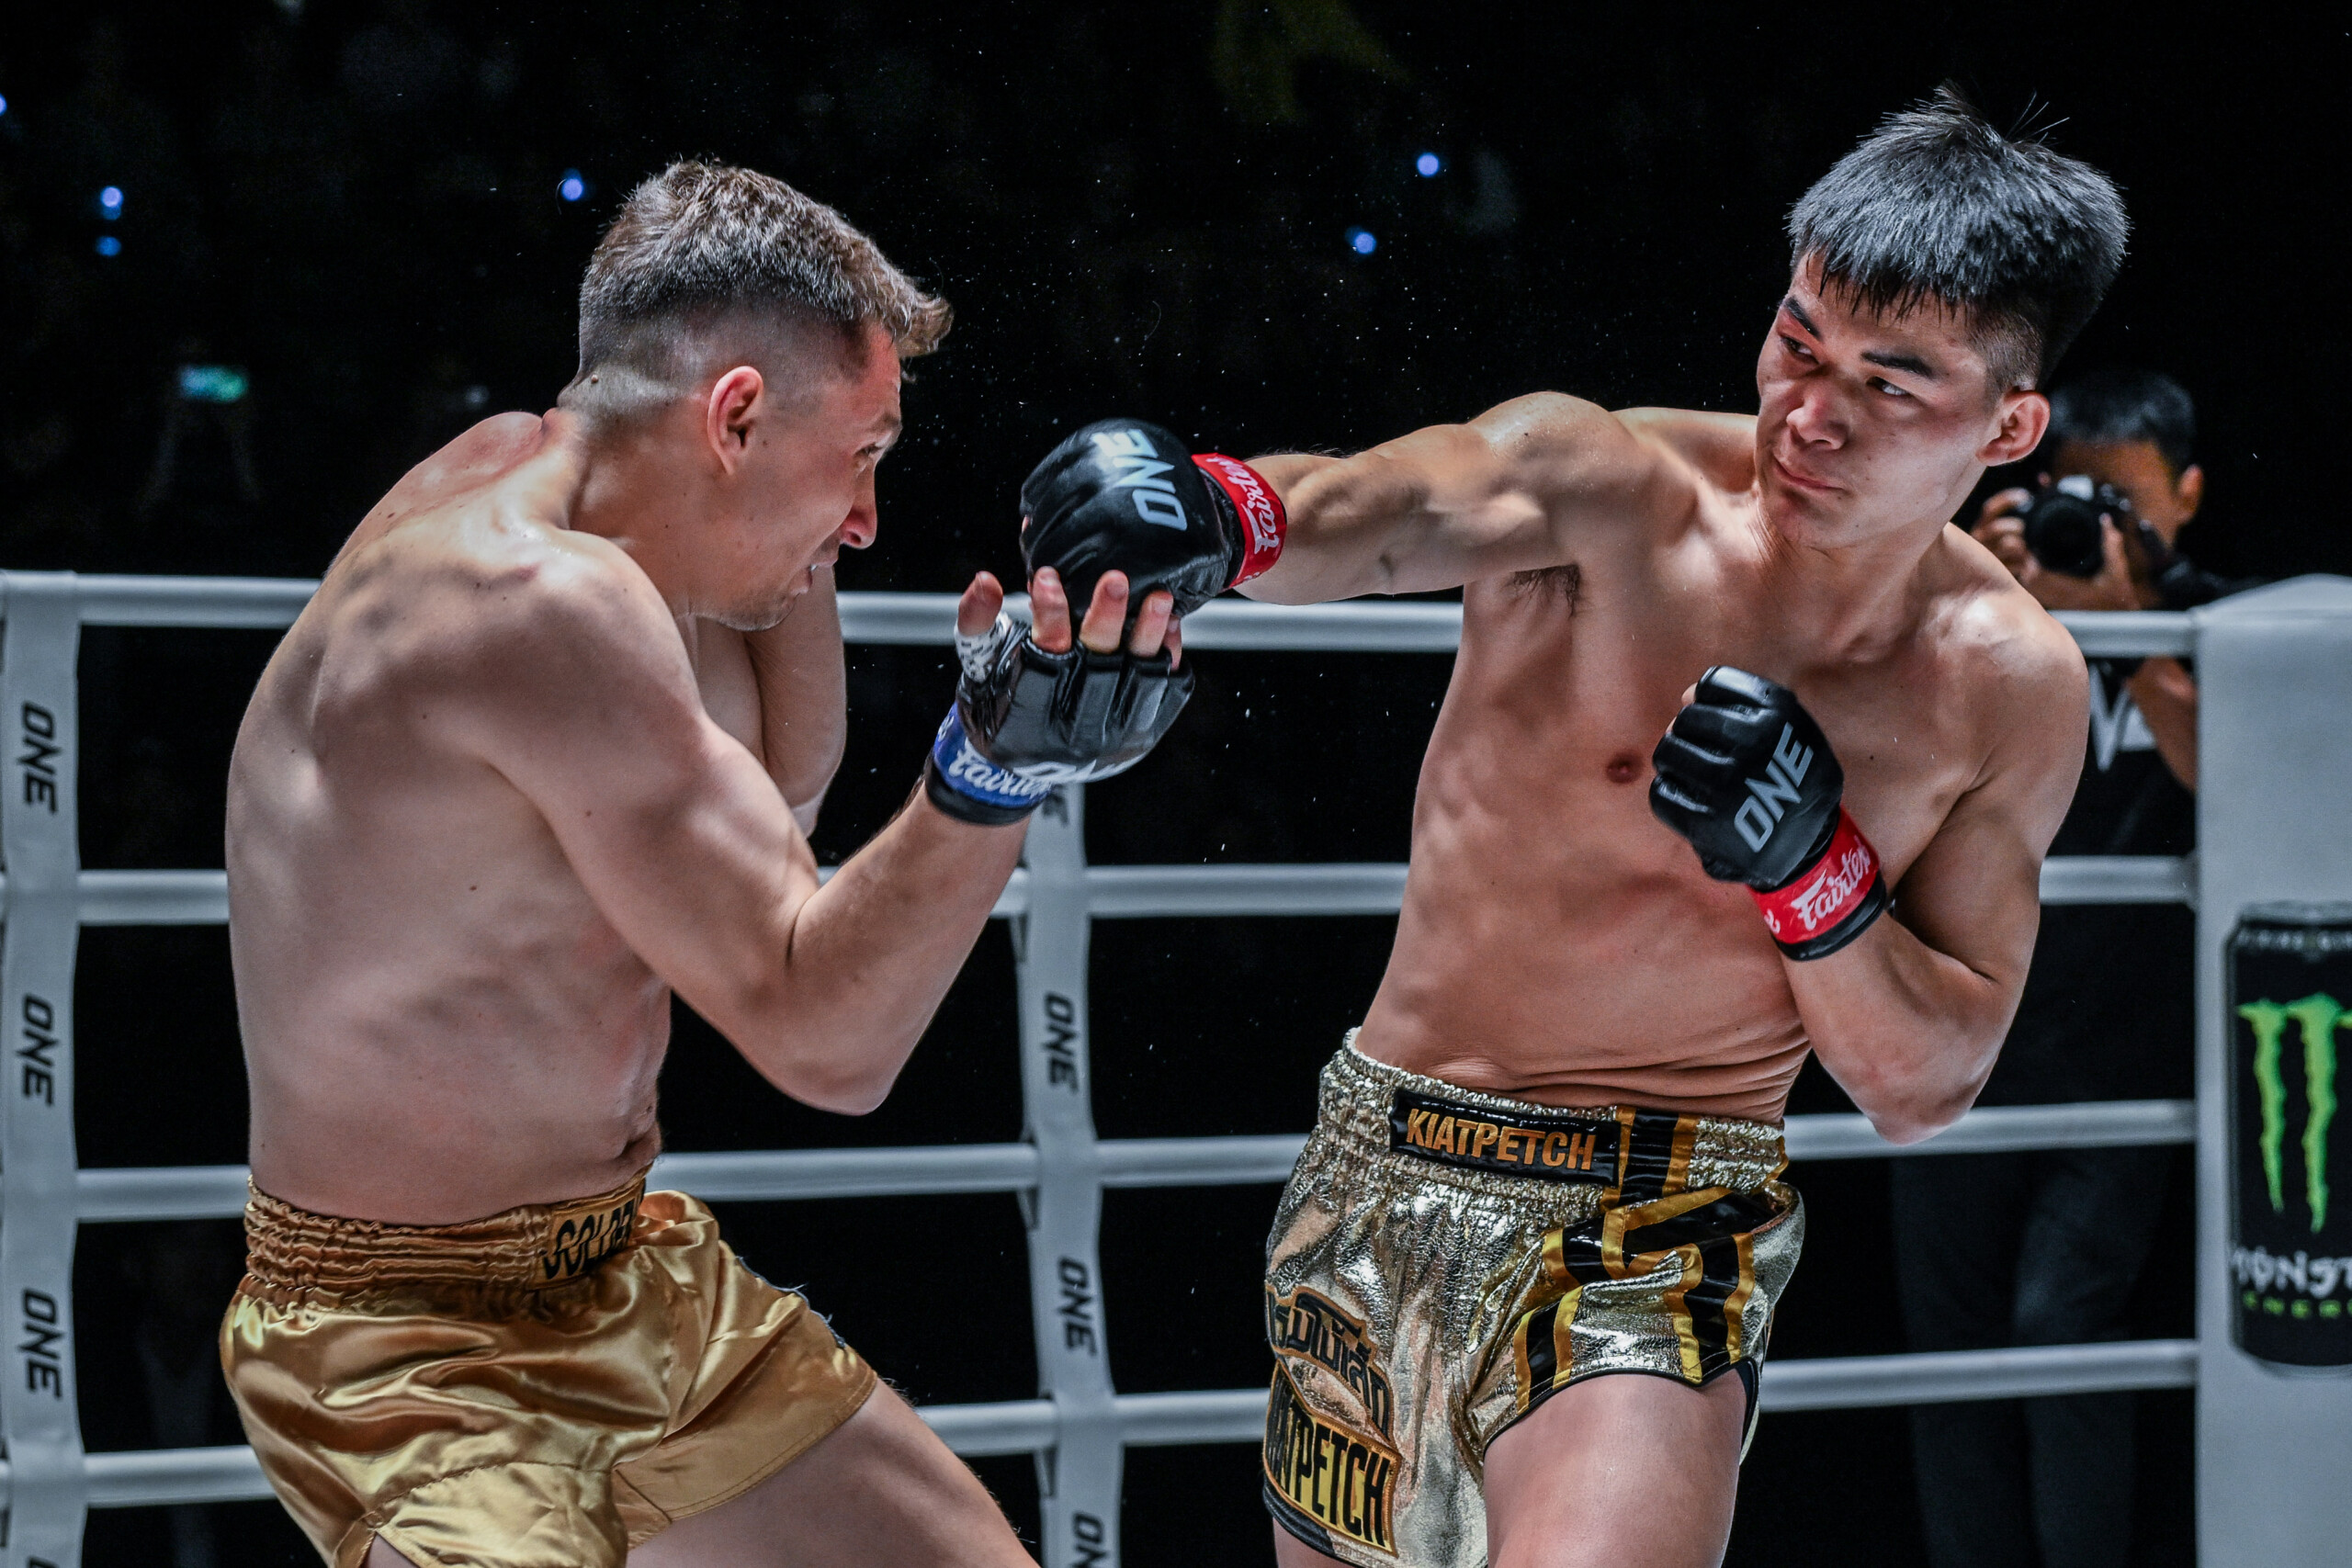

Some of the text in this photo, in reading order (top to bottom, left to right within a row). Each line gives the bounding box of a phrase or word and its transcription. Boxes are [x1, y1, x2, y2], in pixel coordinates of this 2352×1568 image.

[1091, 429, 1188, 532] ONE
[17, 701, 62, 815] ONE
[1734, 721, 1814, 853] ONE
[1791, 835, 1871, 931] Fairtex
[17, 994, 59, 1106] ONE
[1042, 993, 1079, 1094] ONE
[1406, 1108, 1597, 1170] KIATPETCH
[17, 1289, 63, 1400] ONE
[1057, 1257, 1098, 1356] ONE
